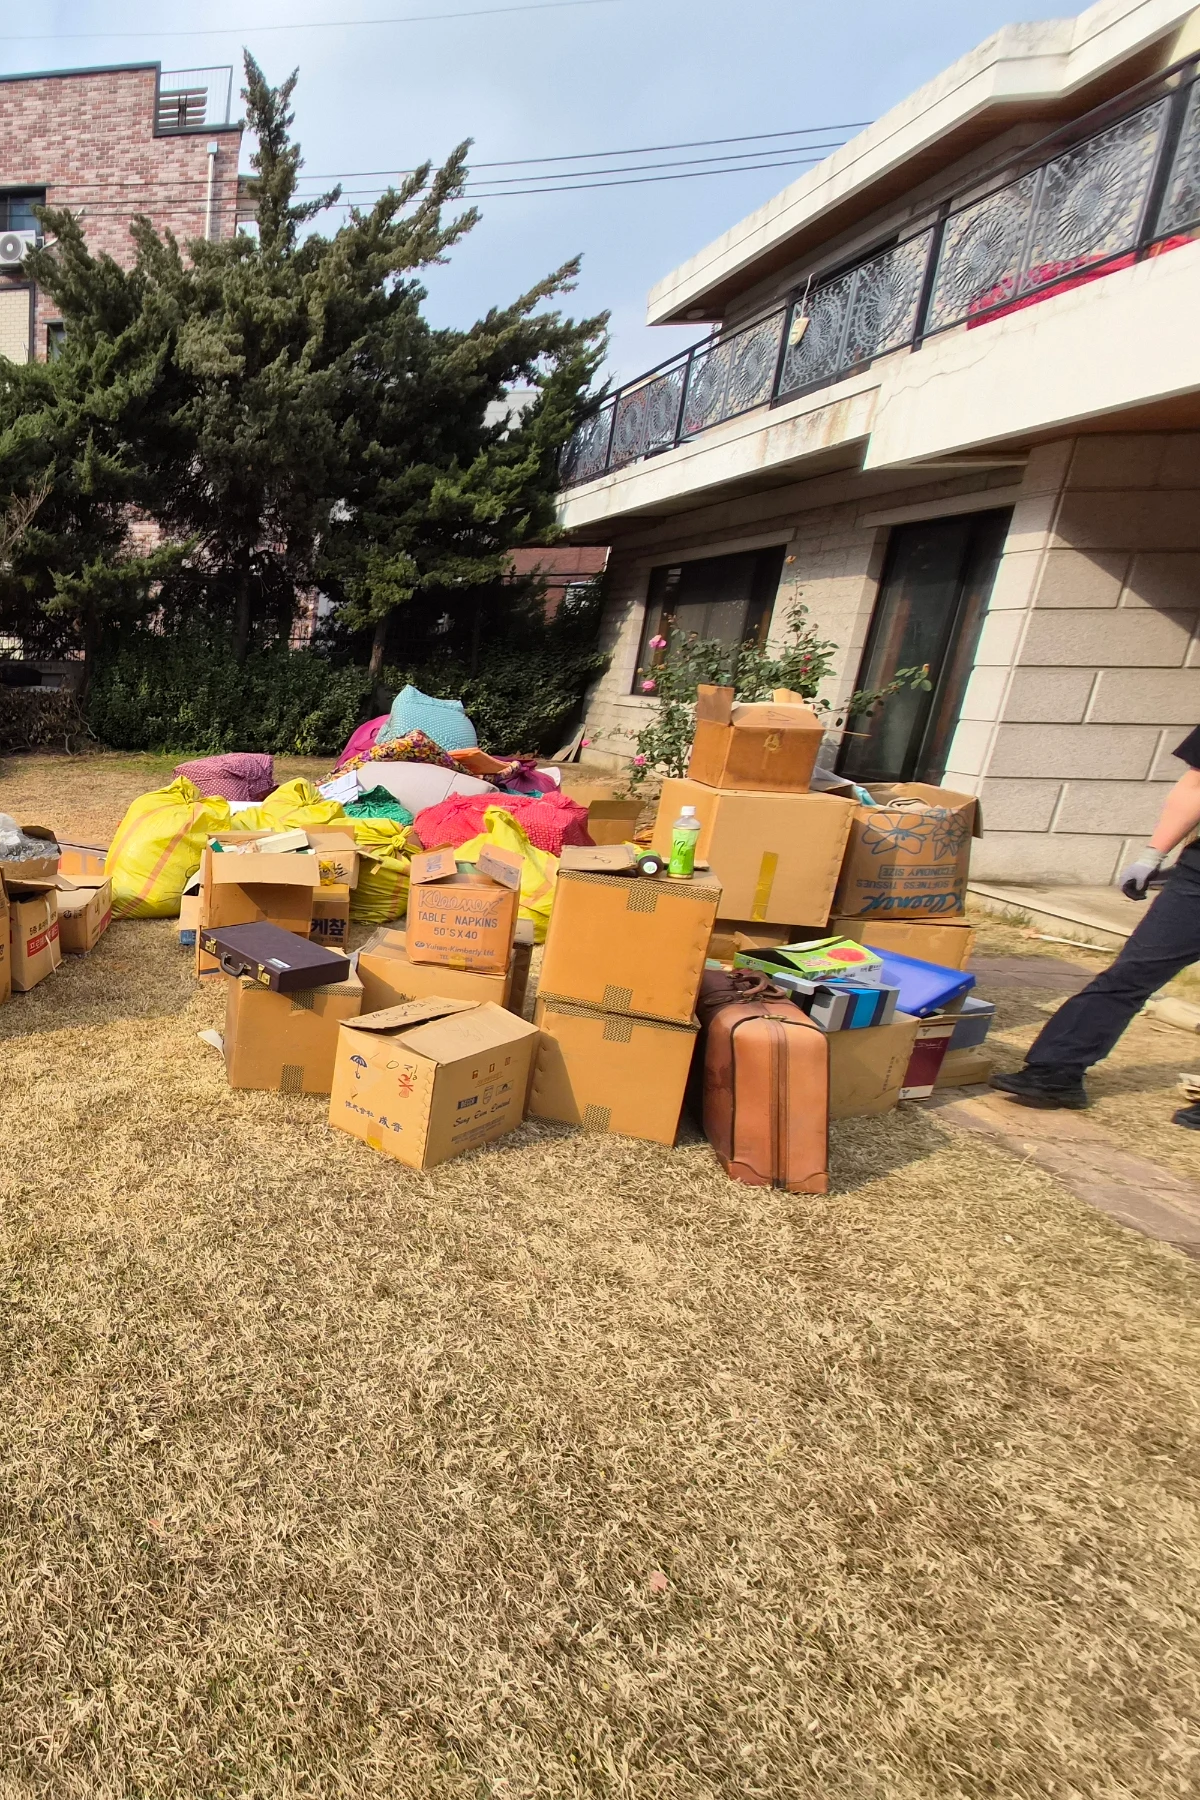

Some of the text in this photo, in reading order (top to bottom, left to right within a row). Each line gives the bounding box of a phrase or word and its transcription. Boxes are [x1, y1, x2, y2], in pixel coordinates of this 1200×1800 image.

[882, 867, 905, 876] SIZE
[856, 879, 897, 889] TISSUES
[903, 880, 949, 889] SOFTNESS
[418, 889, 499, 917] Kleenex
[861, 891, 964, 913] Kleenex
[417, 911, 498, 928] TABLE NAPKINS
